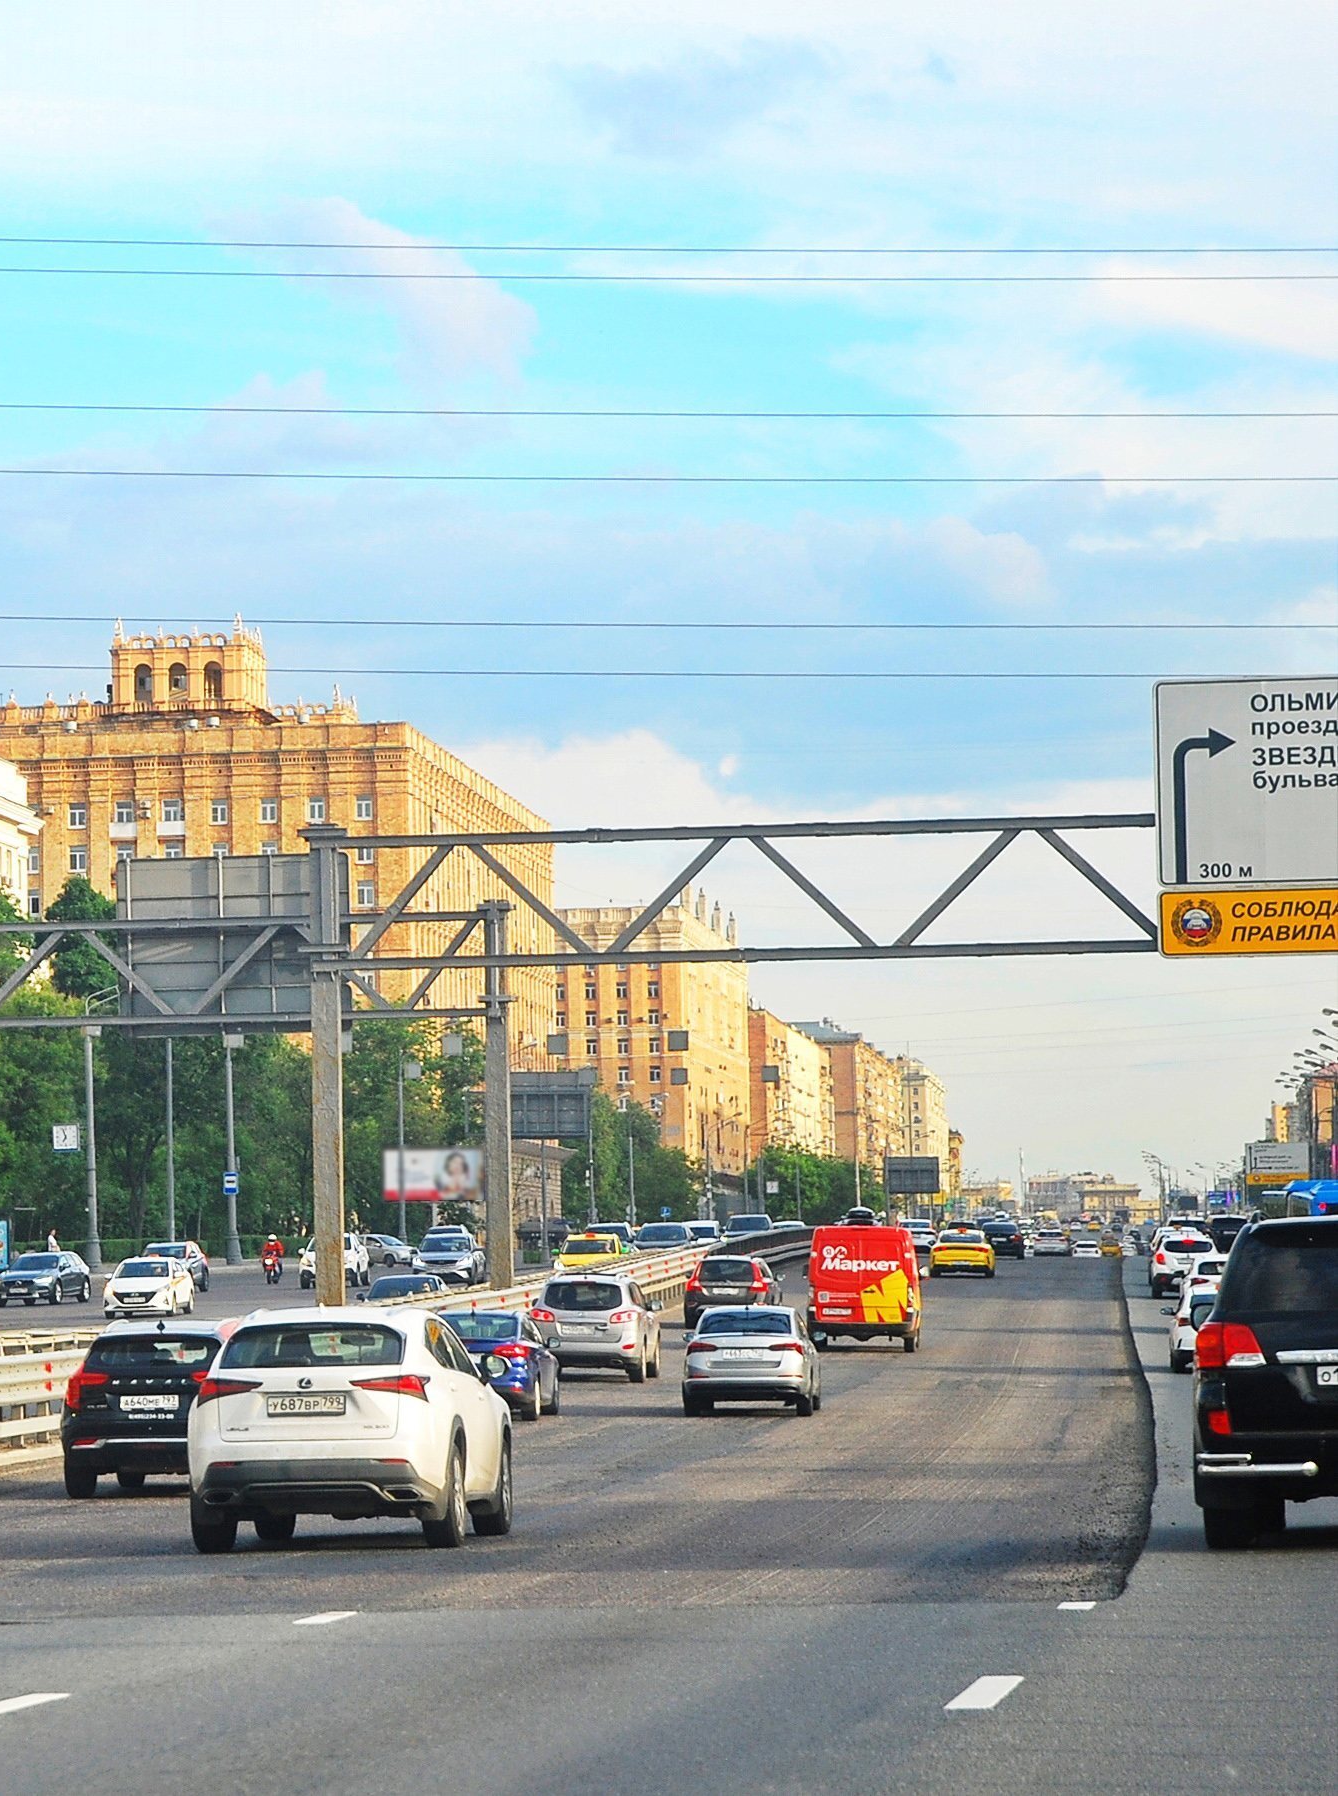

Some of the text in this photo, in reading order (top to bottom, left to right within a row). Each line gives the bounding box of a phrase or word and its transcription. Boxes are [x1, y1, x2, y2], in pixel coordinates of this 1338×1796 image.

[1251, 720, 1338, 739] проезд
[1252, 746, 1338, 767] ЗВЕЗД
[1199, 863, 1252, 878] 300 м
[1231, 924, 1336, 942] ПРАВИЛА
[821, 1258, 900, 1273] Маркет
